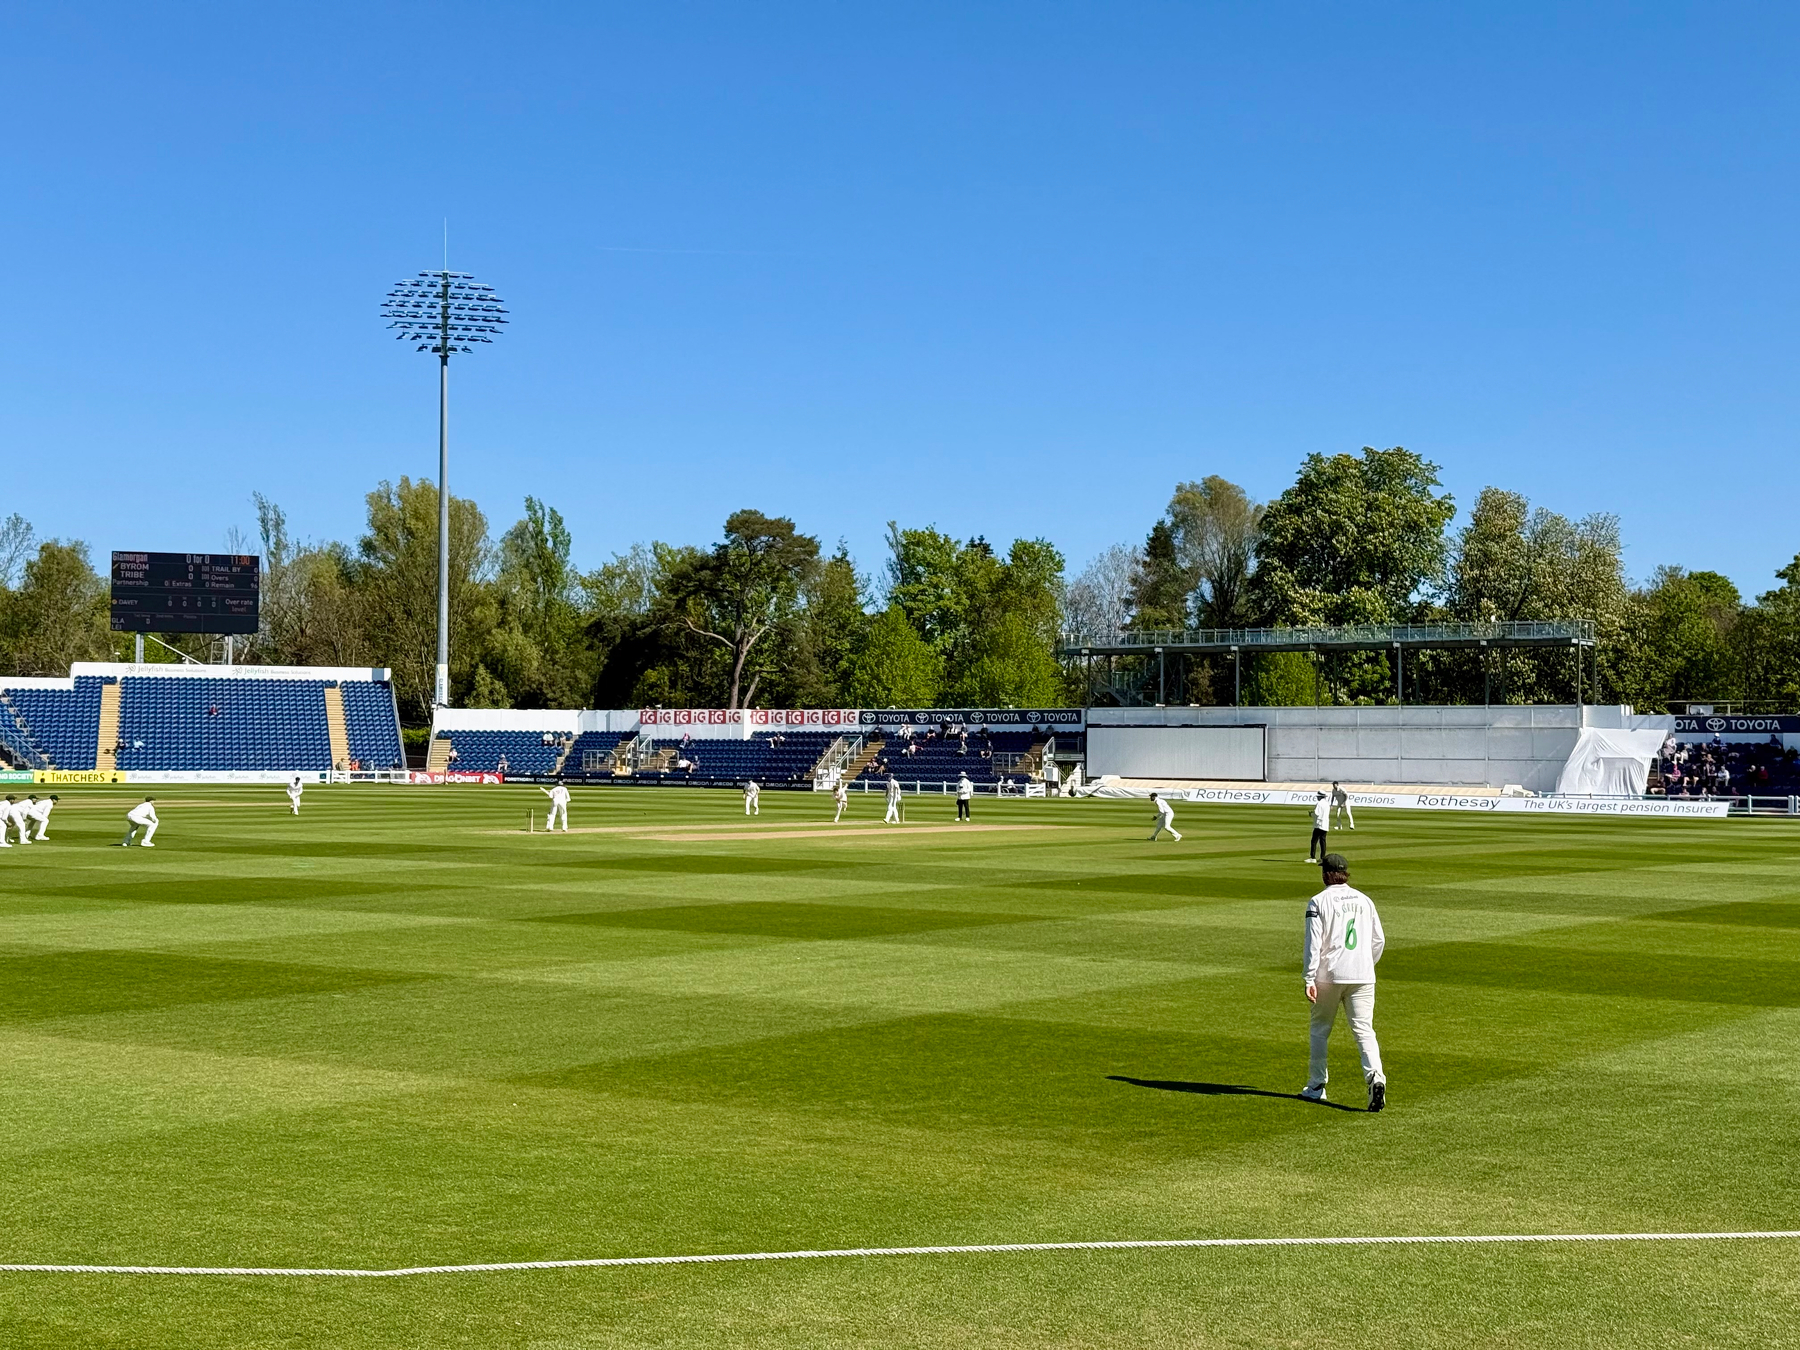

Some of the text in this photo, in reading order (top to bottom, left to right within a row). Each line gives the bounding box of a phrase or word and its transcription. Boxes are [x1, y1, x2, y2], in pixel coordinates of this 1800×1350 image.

[112, 552, 148, 562] Glamorgan
[193, 554, 204, 564] for
[878, 714, 910, 722] TOYOTA
[931, 714, 964, 722] TOYOTA
[986, 713, 1020, 722] TOYOTA
[1043, 713, 1078, 722] TOYOTA
[1730, 720, 1780, 730] TOYOTA
[51, 772, 105, 782] THATCHERS
[1196, 789, 1271, 803] Rothesay
[1416, 795, 1500, 811] Rothesay
[1524, 800, 1544, 809] The
[1576, 802, 1617, 813] largest
[1620, 803, 1669, 813] pension
[1673, 803, 1719, 814] insurer
[1345, 918, 1357, 950] 6
